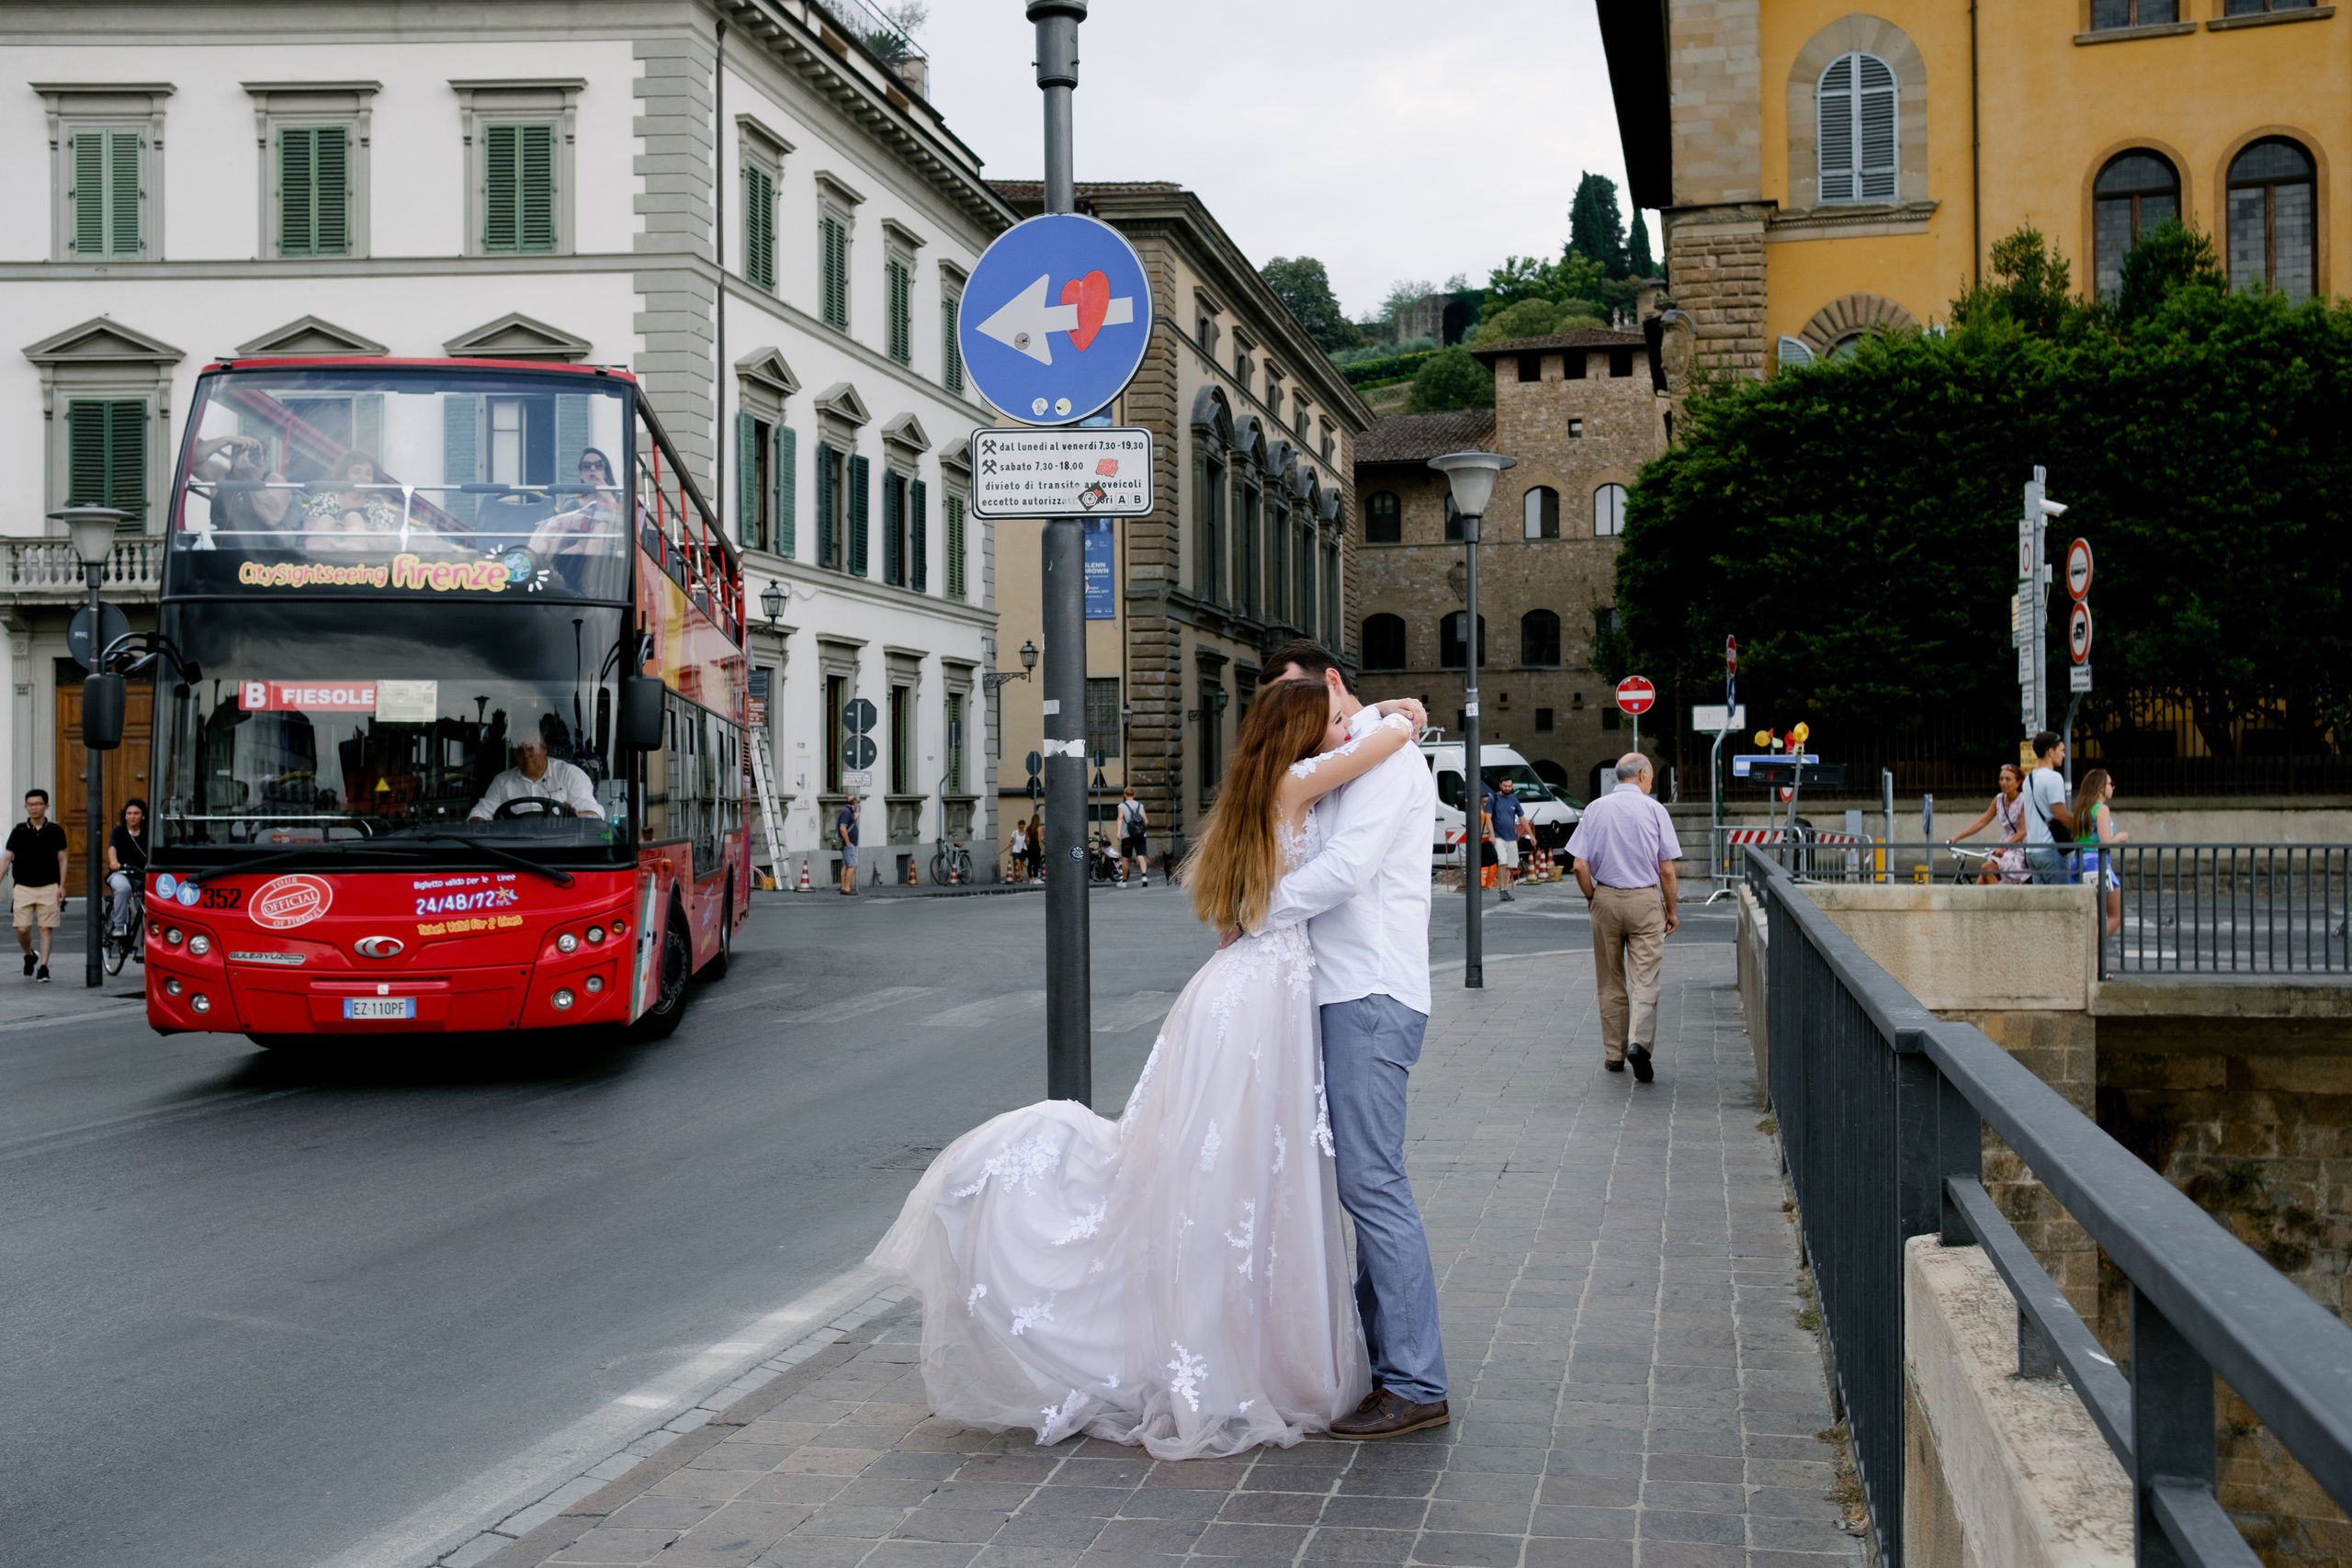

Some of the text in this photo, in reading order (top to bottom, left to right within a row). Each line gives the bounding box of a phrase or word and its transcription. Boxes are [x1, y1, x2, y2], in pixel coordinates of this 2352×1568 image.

[1000, 442, 1014, 451] dal
[1017, 442, 1047, 451] lunedi
[1049, 442, 1059, 451] al
[1062, 441, 1097, 450] venerdi
[1099, 441, 1116, 450] 7.30
[1000, 462, 1032, 471] sabato
[1035, 461, 1053, 471] 7.30
[1059, 461, 1084, 470] 18.00
[985, 481, 1020, 491] divieto
[1024, 481, 1034, 490] di
[1038, 480, 1080, 490] transito
[982, 497, 1019, 506] eccetto
[1118, 495, 1126, 504] A
[1134, 495, 1141, 504] B
[238, 553, 510, 592] CitySightseeing Firenze
[245, 682, 266, 708] B
[282, 689, 375, 705] FIESOLE
[271, 877, 298, 889] TOUR
[413, 880, 444, 890] Biglietto
[445, 877, 465, 886] valido
[466, 877, 480, 886] per
[496, 874, 516, 882] Linee
[202, 888, 241, 909] 352
[264, 892, 318, 913] OFFICIAL
[415, 890, 496, 916] 24/48/72
[273, 907, 322, 927] OF FIRENZE
[417, 922, 447, 936] Ticket
[447, 919, 470, 933] Valid
[488, 917, 496, 930] 2
[497, 915, 523, 928] Lines
